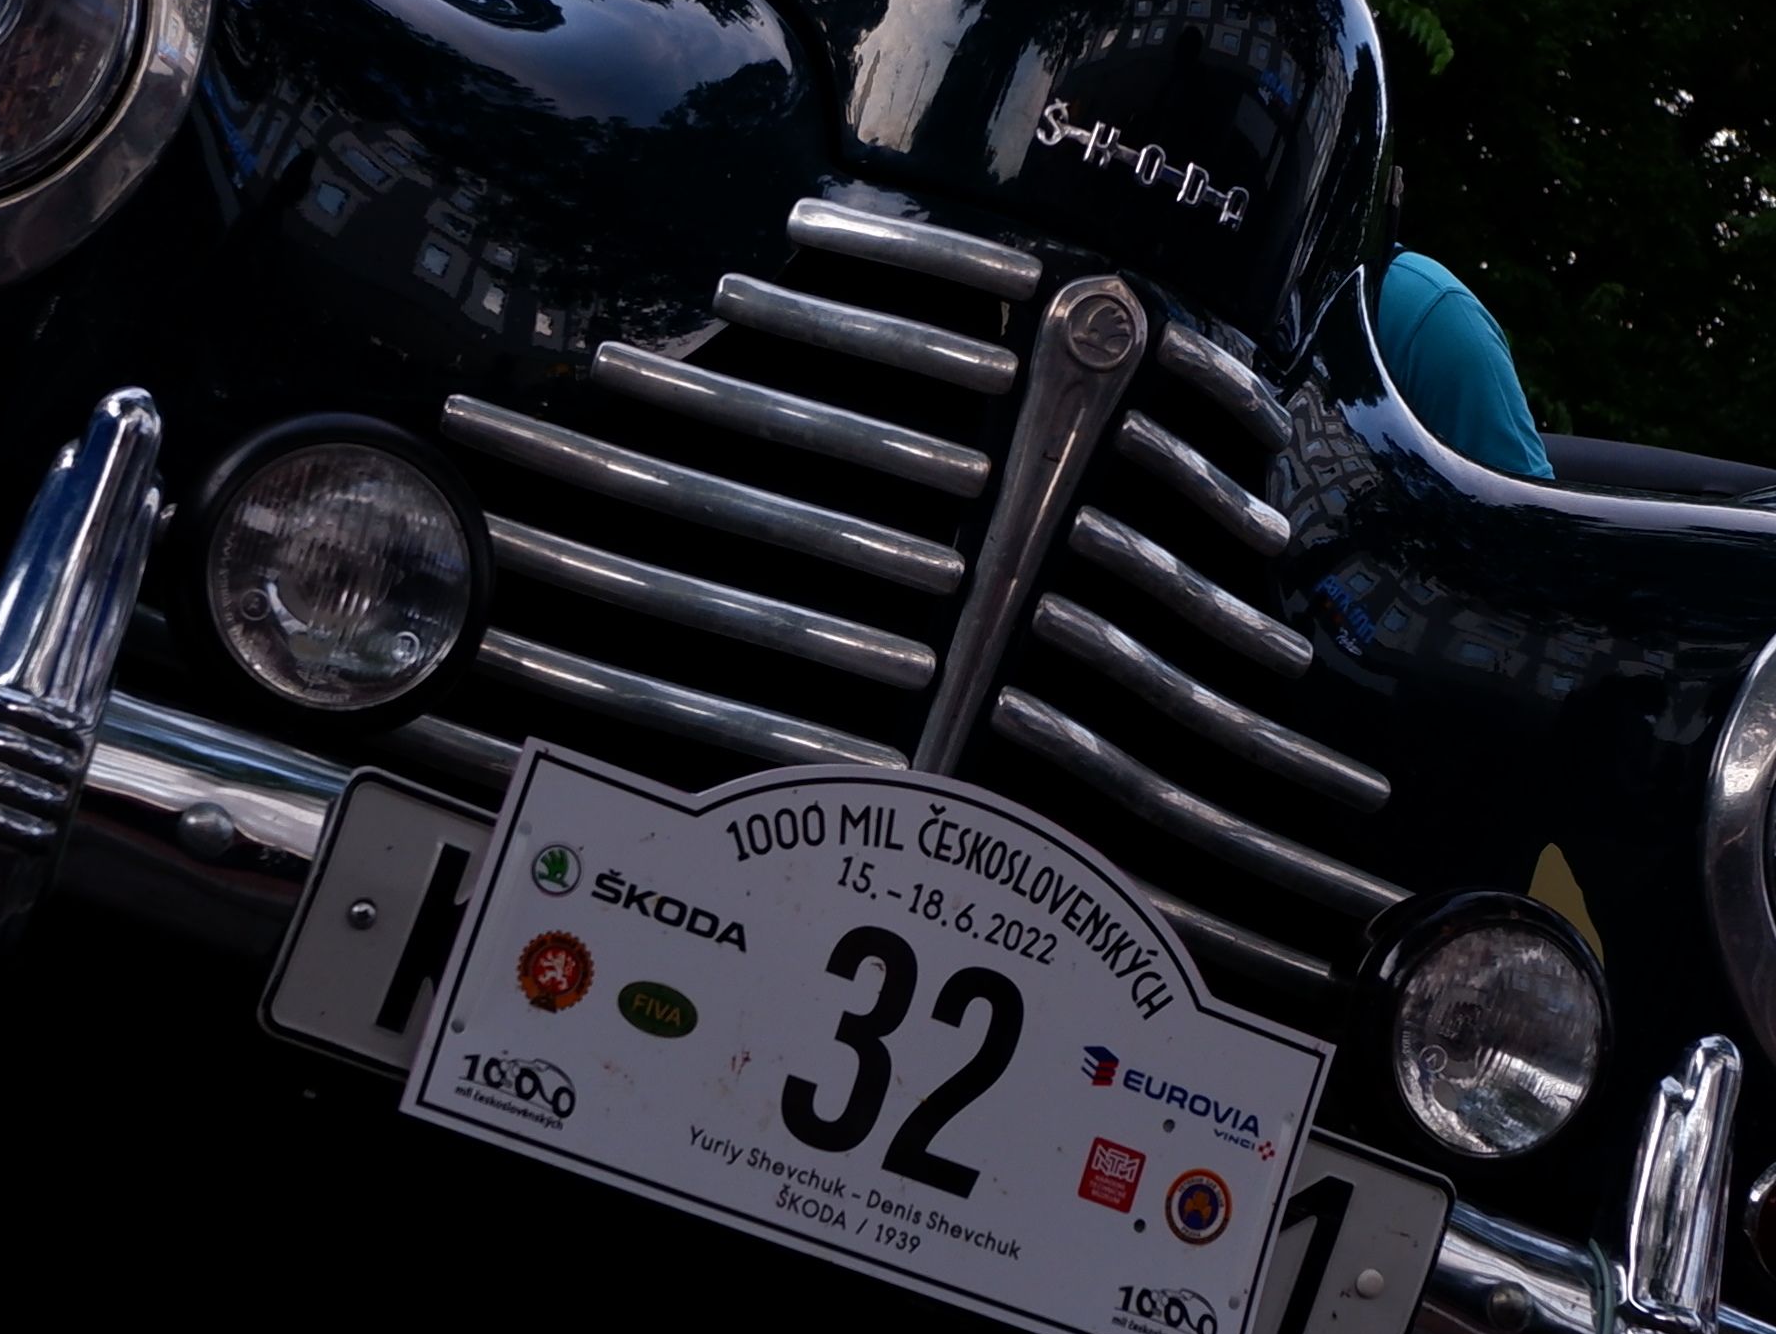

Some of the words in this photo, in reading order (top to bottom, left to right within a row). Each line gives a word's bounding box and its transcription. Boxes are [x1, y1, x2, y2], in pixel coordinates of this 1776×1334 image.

[591, 869, 747, 952] ŠKODA
[726, 804, 825, 862] 1000
[839, 804, 904, 851] MIL
[918, 802, 1173, 1020] ČESKOSLOVENSKÝCH
[631, 992, 684, 1026] FIVA
[781, 926, 1024, 1199] 32
[1123, 1069, 1260, 1138] EUROVIA
[1213, 1128, 1256, 1151] VINCI
[690, 1125, 742, 1165] Yuriy
[746, 1147, 846, 1199] Shevchuk
[866, 1189, 923, 1225] Denis
[925, 1211, 1021, 1261] Shevchuk
[775, 1184, 847, 1231] ŠKODA
[874, 1224, 922, 1255] 1939
